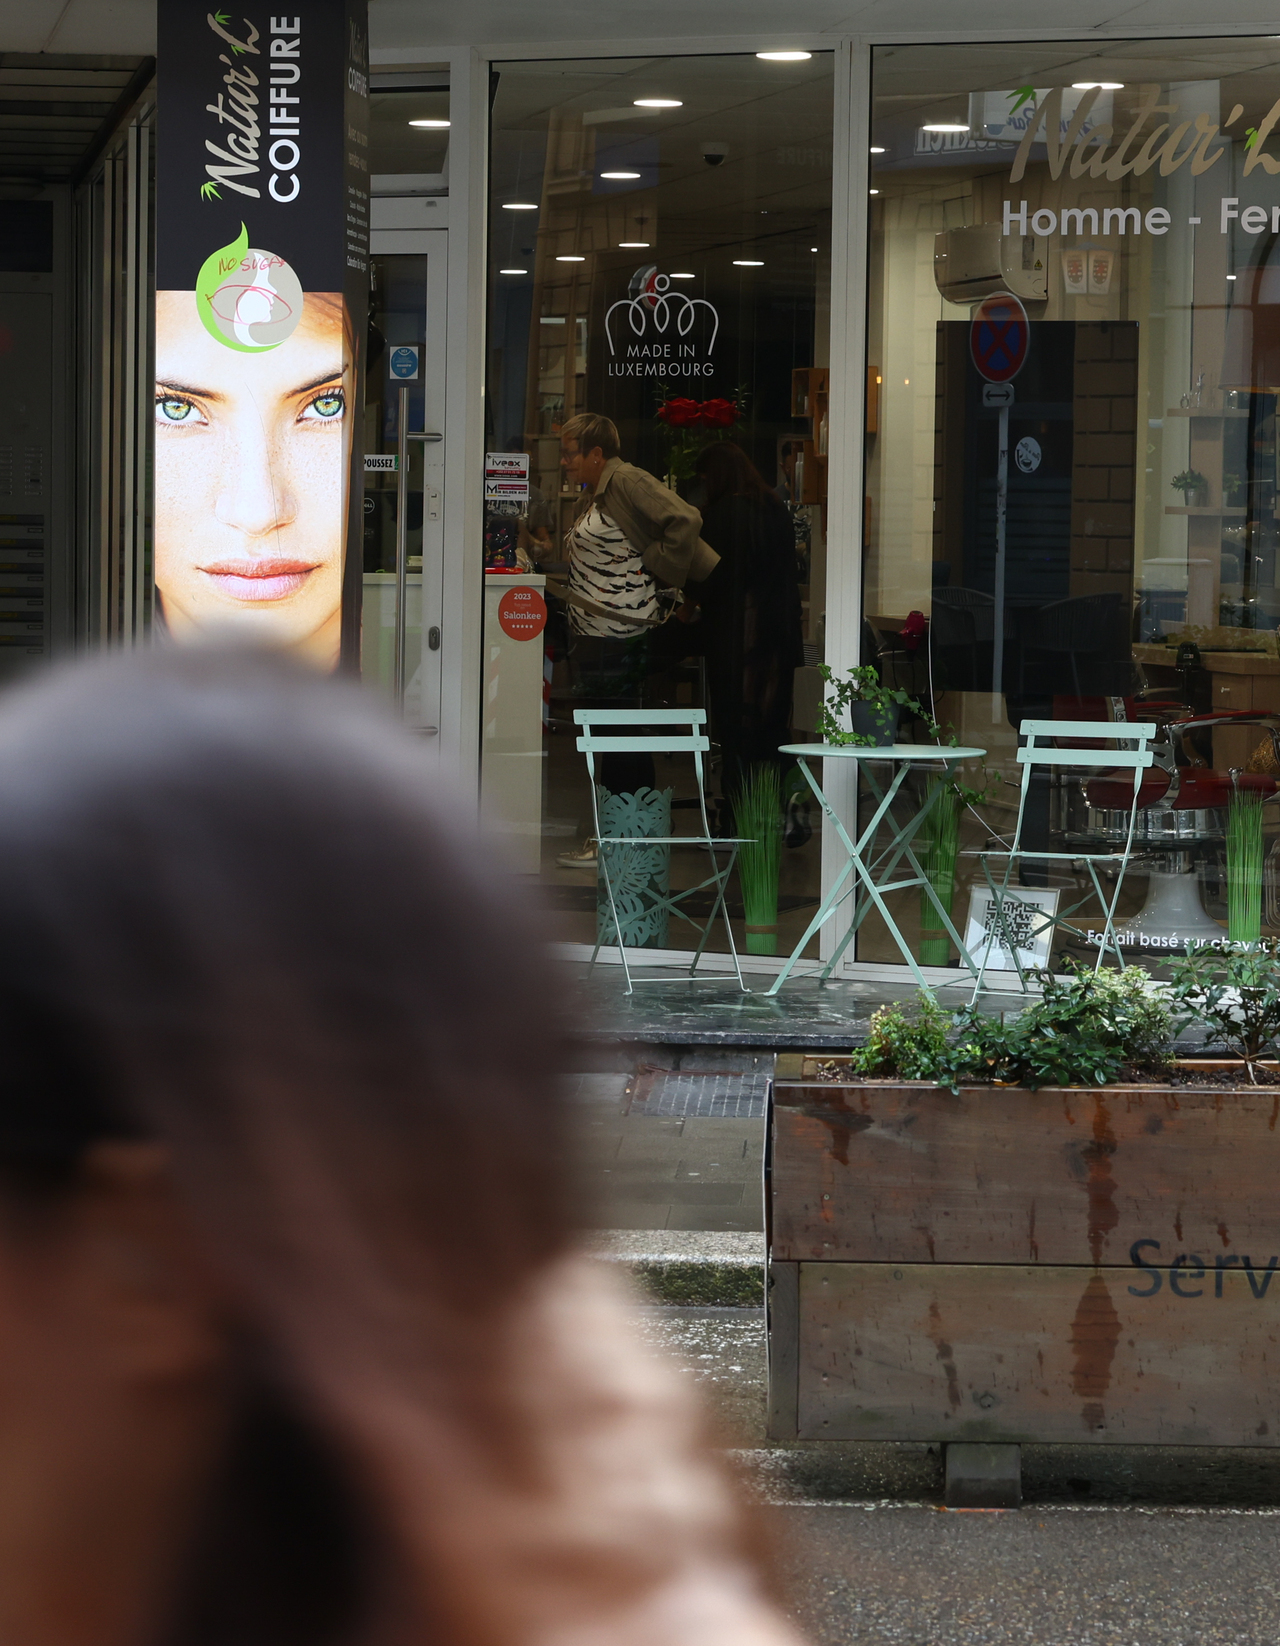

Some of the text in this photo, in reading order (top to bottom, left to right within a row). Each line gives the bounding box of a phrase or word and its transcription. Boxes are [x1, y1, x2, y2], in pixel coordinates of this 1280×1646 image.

[268, 16, 301, 203] COIFFURE
[1003, 200, 1171, 236] Homme
[219, 257, 237, 275] NO
[627, 344, 695, 357] MADE IN
[608, 363, 714, 376] LUXEMBOURG
[503, 611, 541, 619] Salonkee
[1140, 931, 1178, 948] basé
